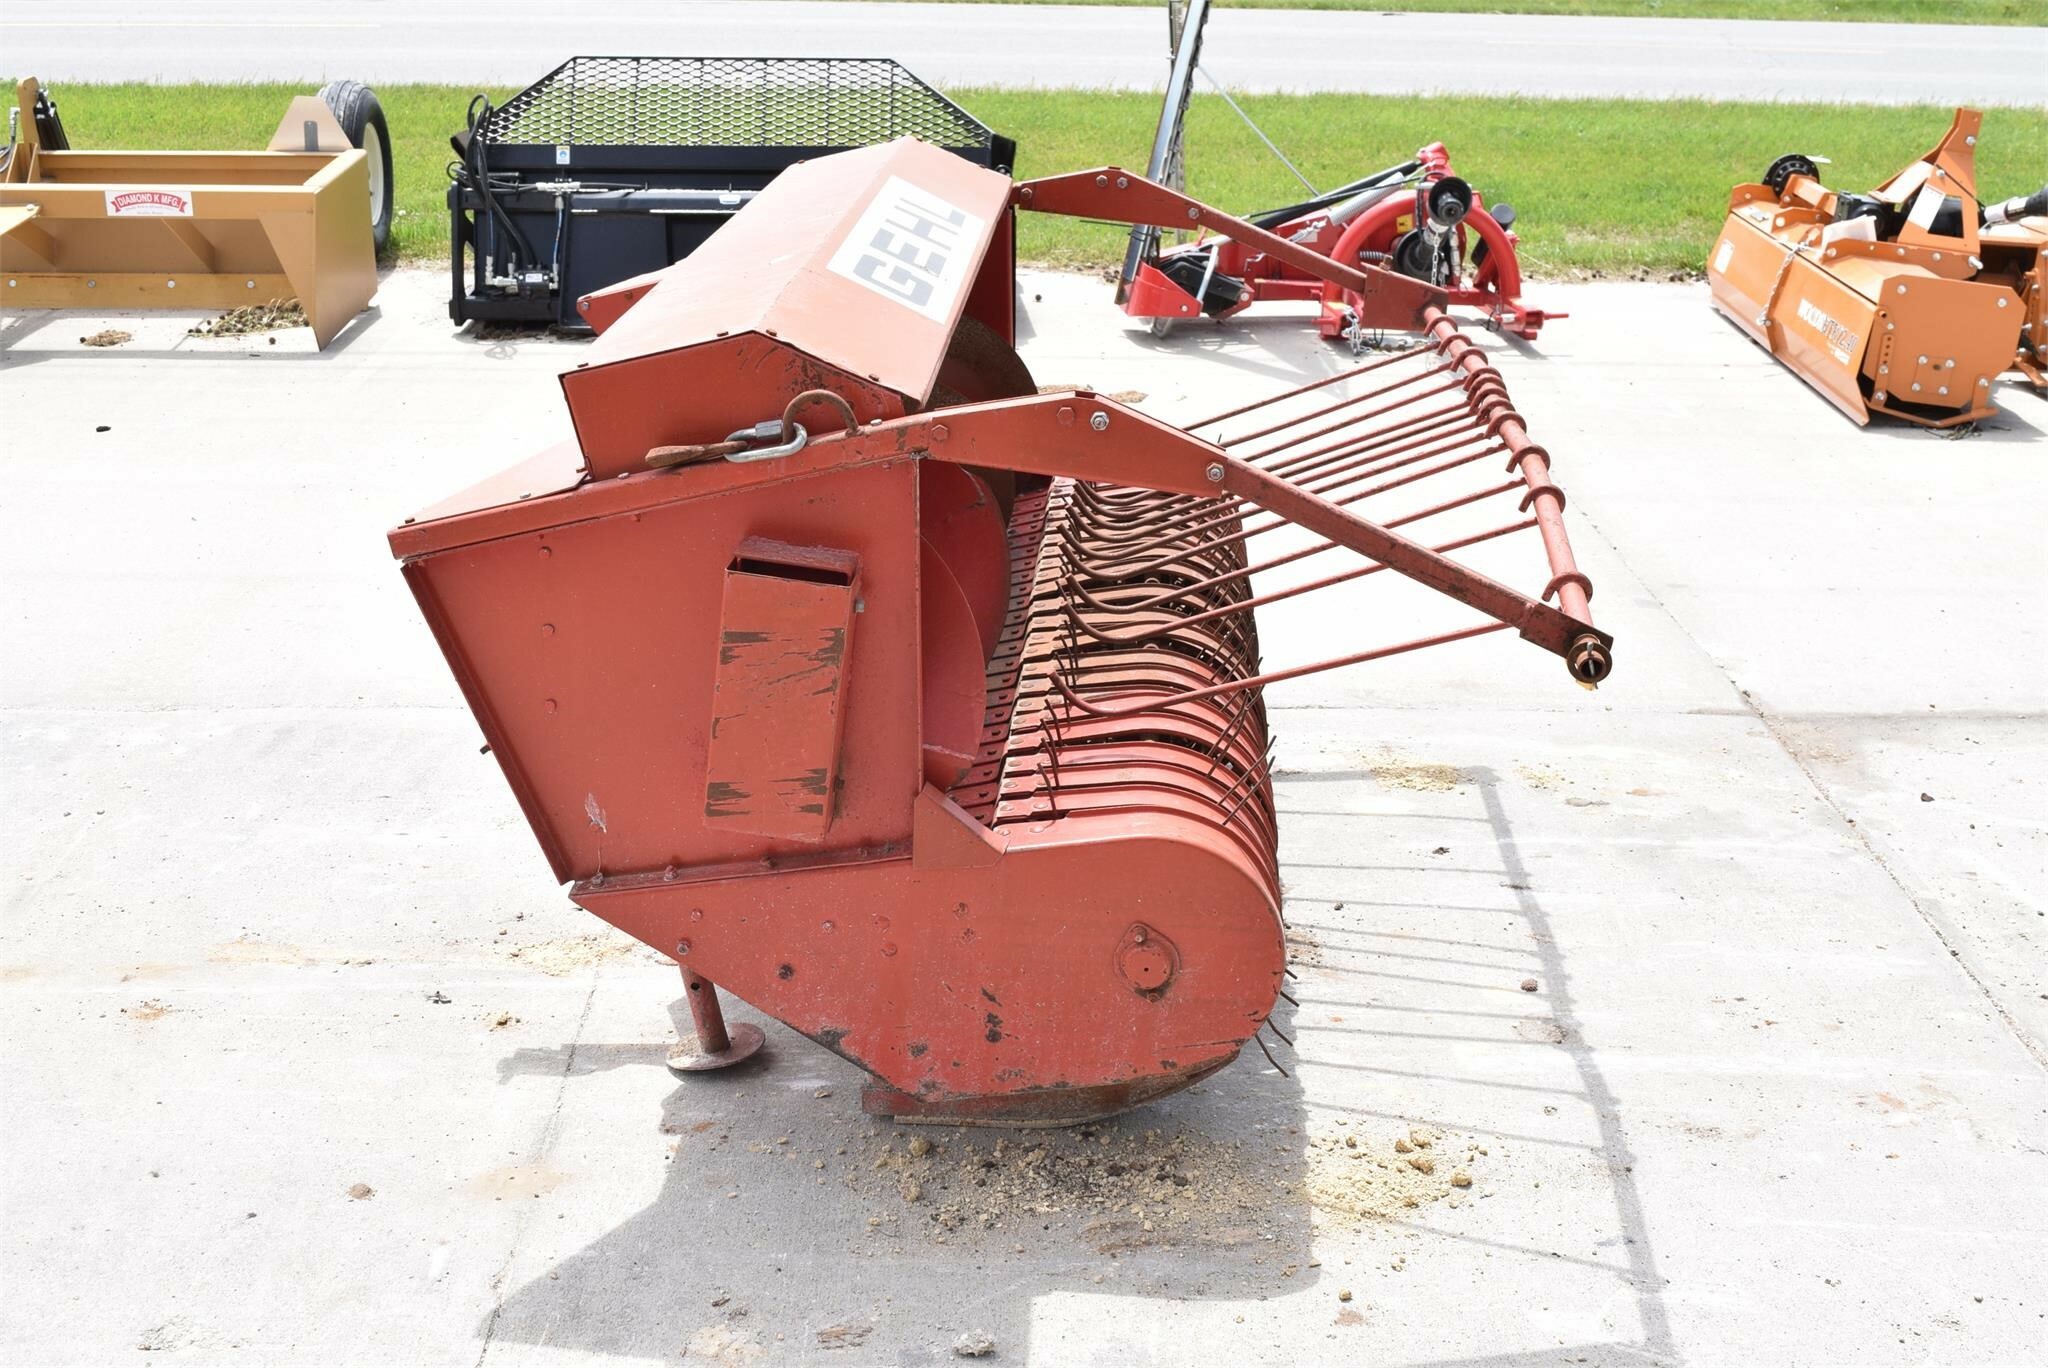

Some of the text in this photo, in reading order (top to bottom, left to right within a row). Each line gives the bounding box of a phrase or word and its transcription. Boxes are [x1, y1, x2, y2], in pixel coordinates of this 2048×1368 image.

[117, 193, 179, 207] DIAMOND K MFG.
[853, 197, 967, 307] GEHL
